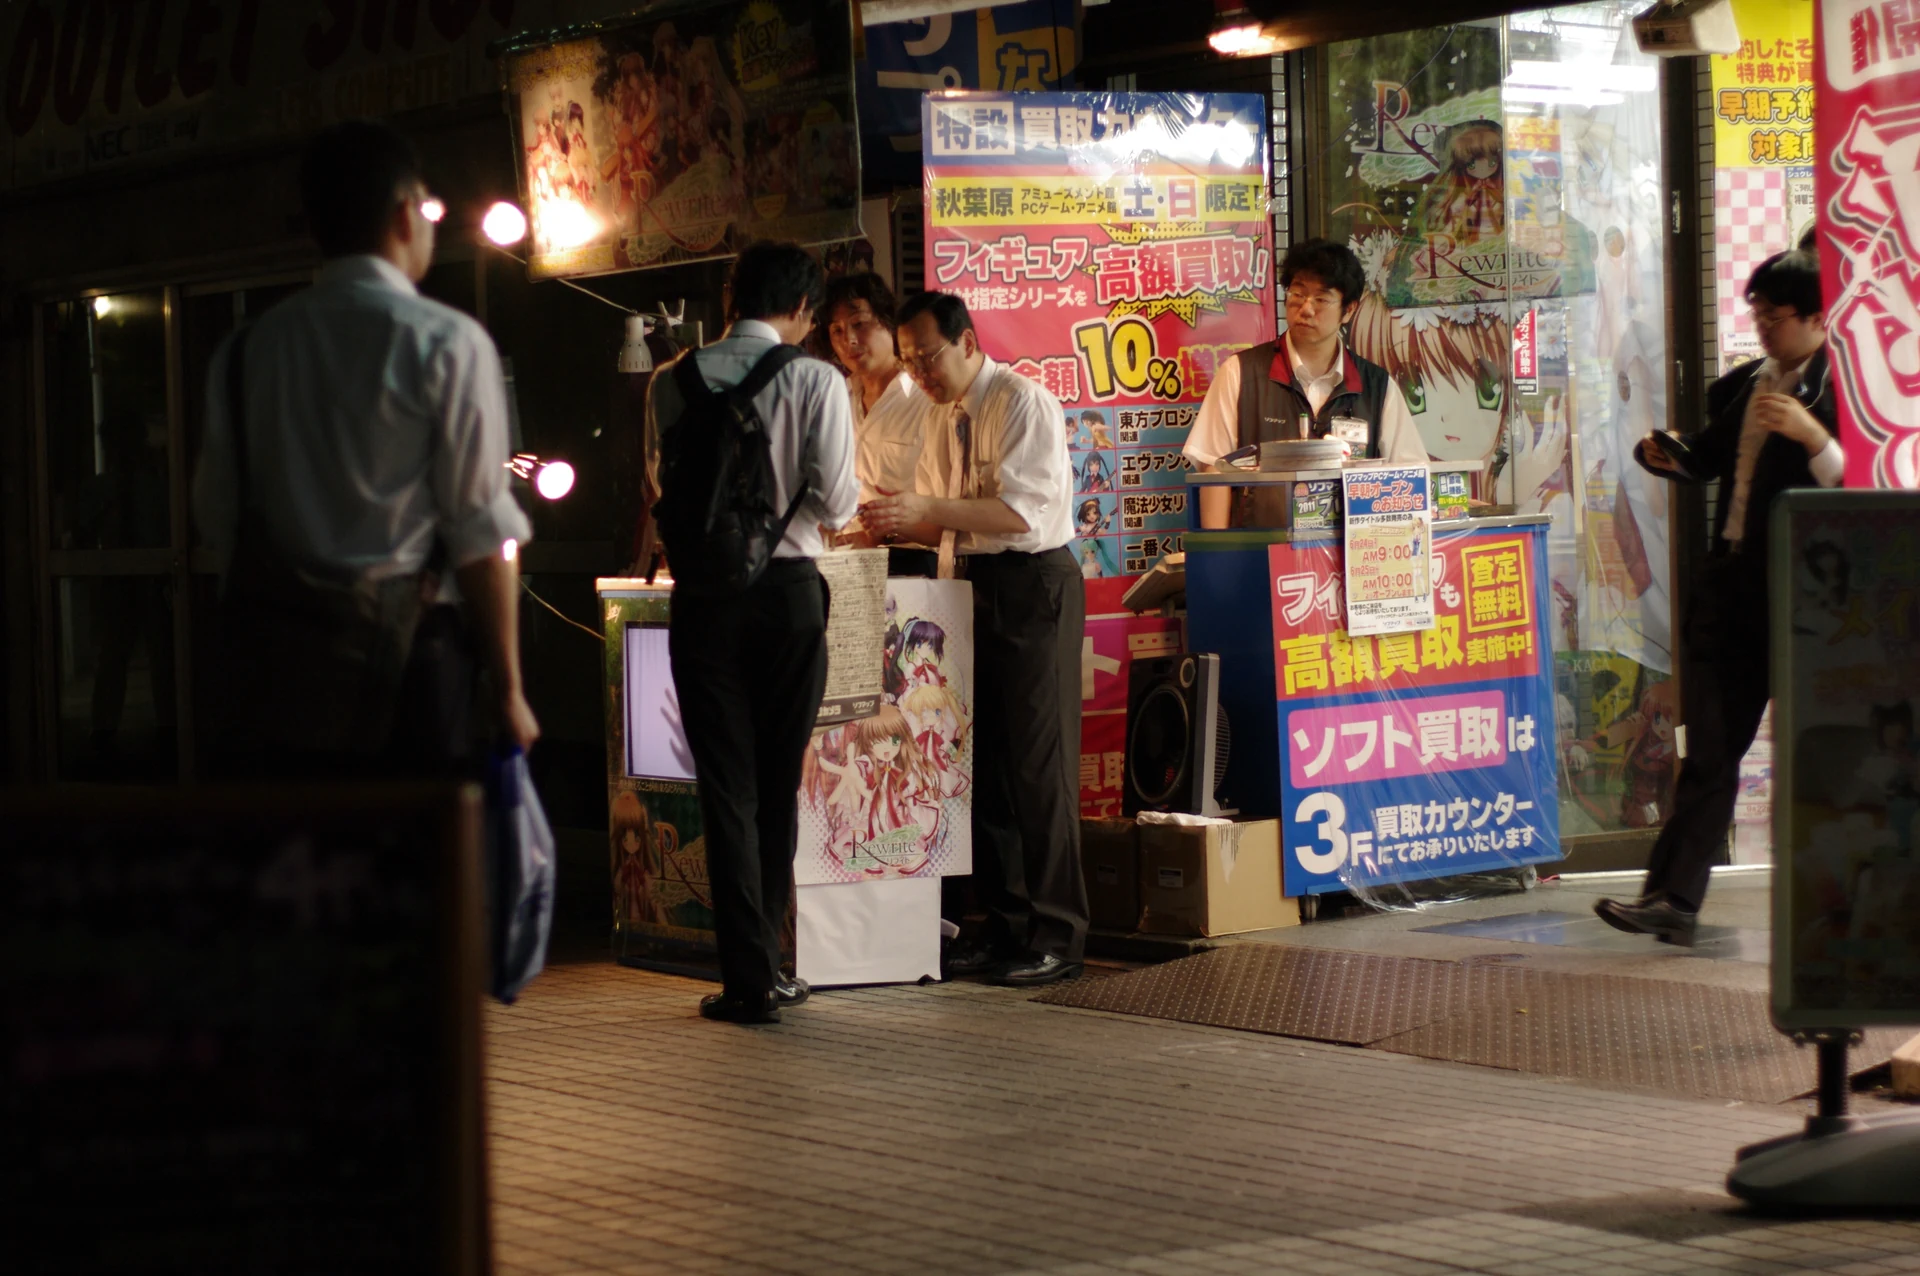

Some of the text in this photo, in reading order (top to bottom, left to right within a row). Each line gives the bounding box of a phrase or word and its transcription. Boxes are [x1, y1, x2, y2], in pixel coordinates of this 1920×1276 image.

[936, 107, 1010, 151] 特設
[936, 187, 1014, 218] 秋葉原
[934, 237, 1088, 283] フィギュア
[1424, 231, 1548, 290] Rewrite
[938, 287, 1087, 311] 社指定シリーズを
[1073, 319, 1183, 400] 10%
[1119, 409, 1199, 430] 東方プロジ
[1119, 430, 1139, 443] 関連
[1121, 474, 1141, 486] 関連
[1348, 480, 1413, 499] 早朝オープン
[1298, 500, 1316, 514] 2011
[1372, 494, 1424, 512] のお知らせ
[1124, 517, 1143, 529] 関連
[1126, 559, 1147, 571] 関連
[1362, 544, 1411, 562] AM9:00
[1362, 572, 1413, 590] AM10:00
[1470, 551, 1519, 588] 査定
[1473, 591, 1522, 622] 無料
[1281, 615, 1532, 695] 高額買取 実施中!
[1293, 706, 1536, 779] ソフト買取は
[1375, 792, 1533, 841] 買取カウンター
[851, 829, 916, 866] Rewrite
[1377, 825, 1535, 866] にてお承りいたします
